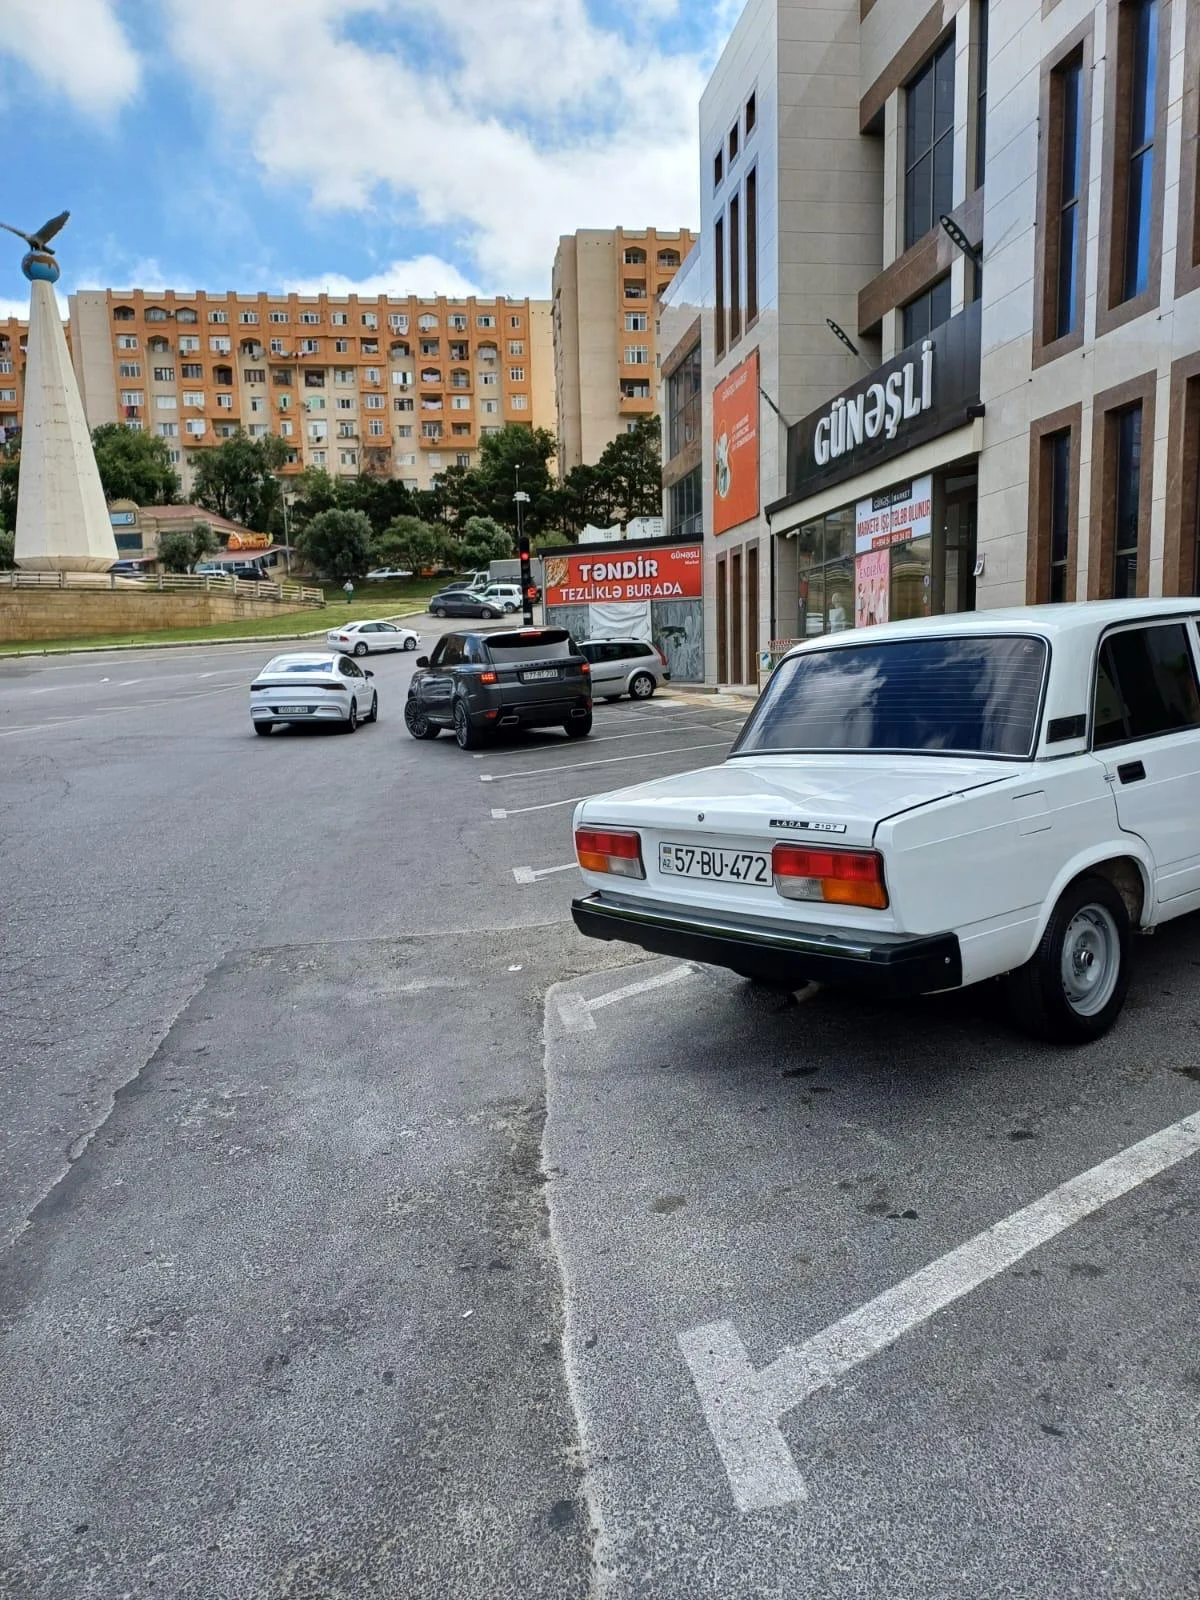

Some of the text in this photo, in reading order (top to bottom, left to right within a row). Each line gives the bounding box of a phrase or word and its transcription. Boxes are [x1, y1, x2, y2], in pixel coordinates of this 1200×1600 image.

[814, 340, 933, 466] GÜNƏŞLİ
[671, 550, 700, 560] GÜNƏŞLİ
[579, 556, 658, 582] TƏNDİR
[560, 582, 683, 601] TEZLİKLƏ BURADA
[776, 820, 801, 828] LADA
[662, 858, 672, 868] AZ
